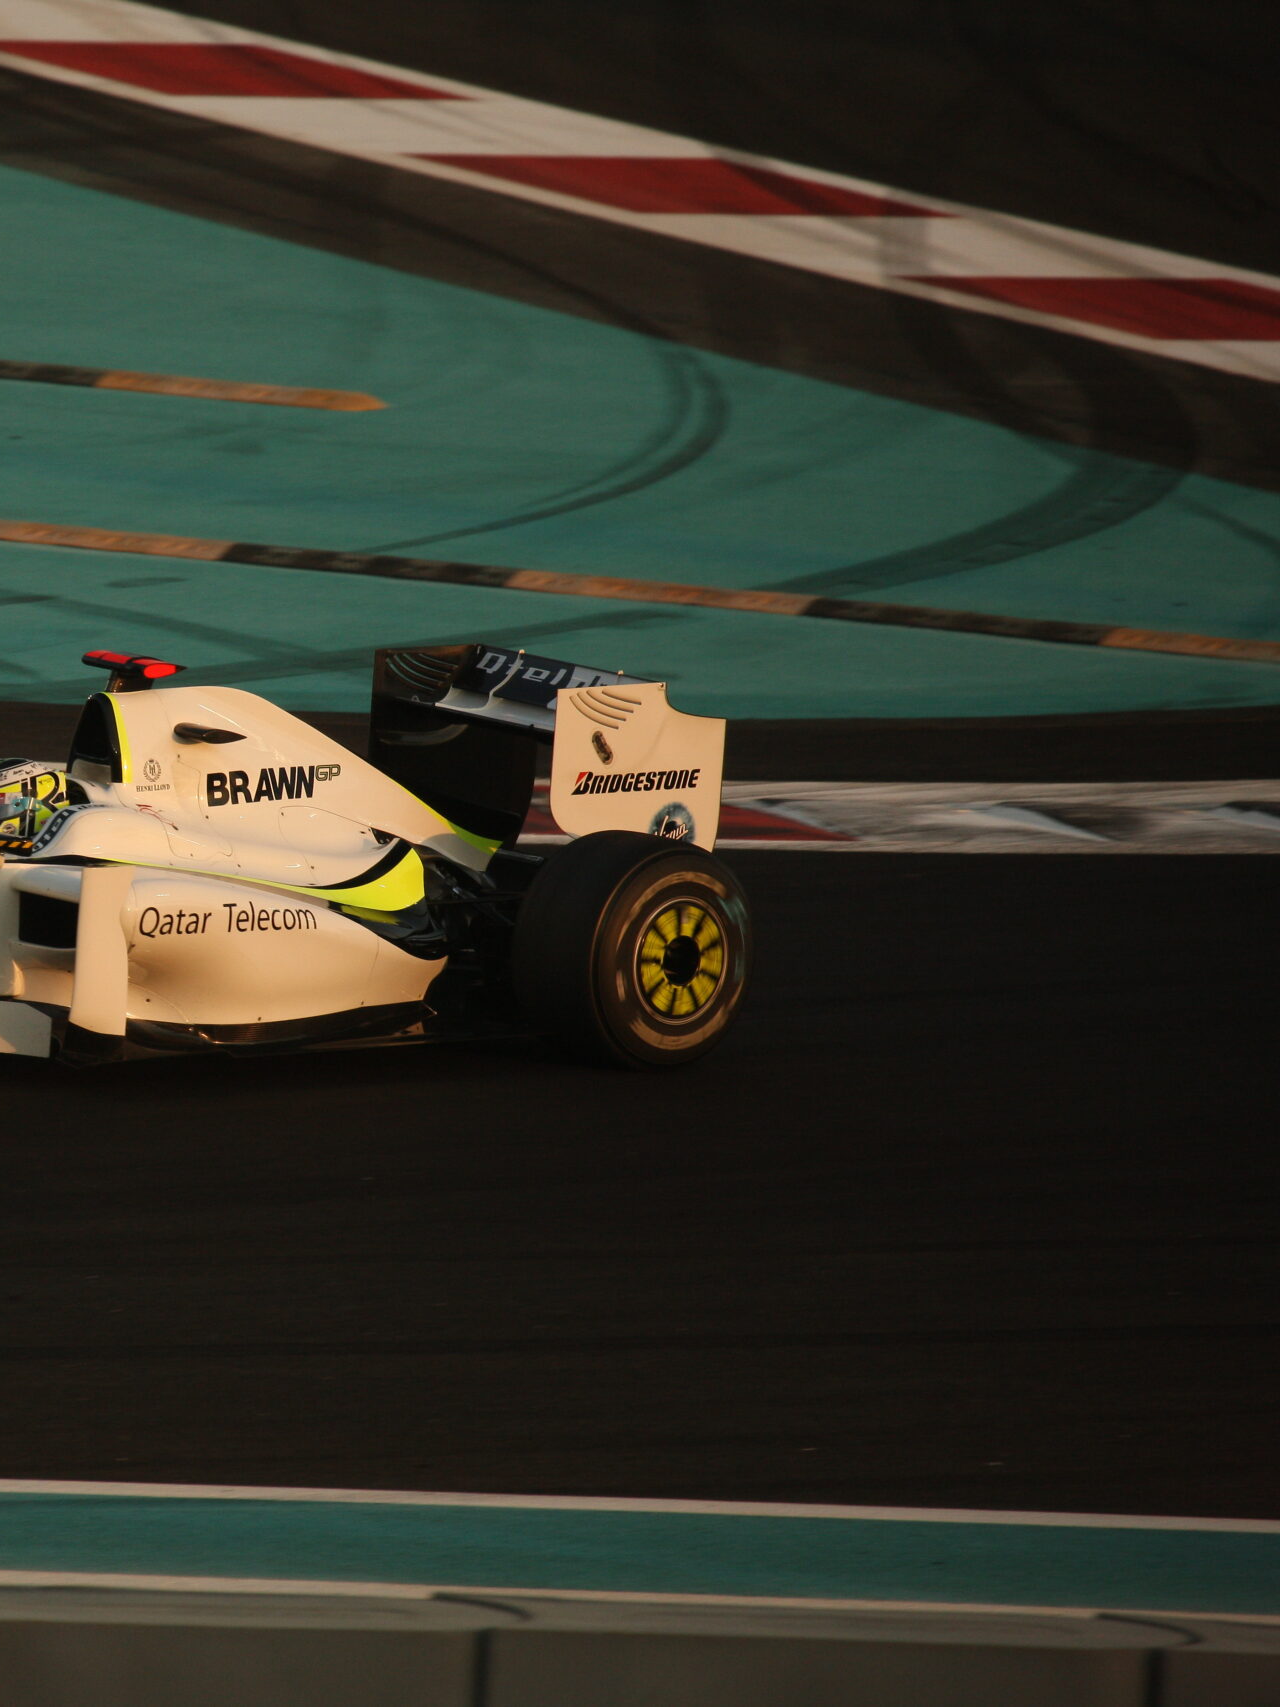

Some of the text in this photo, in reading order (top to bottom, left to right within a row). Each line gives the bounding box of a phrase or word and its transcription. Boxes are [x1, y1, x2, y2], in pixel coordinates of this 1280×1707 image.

[154, 783, 170, 791] LLOYD
[206, 764, 341, 807] BRAWN GP
[571, 768, 701, 796] BRIDGESTONE
[139, 901, 317, 938] Qatar Telecom
